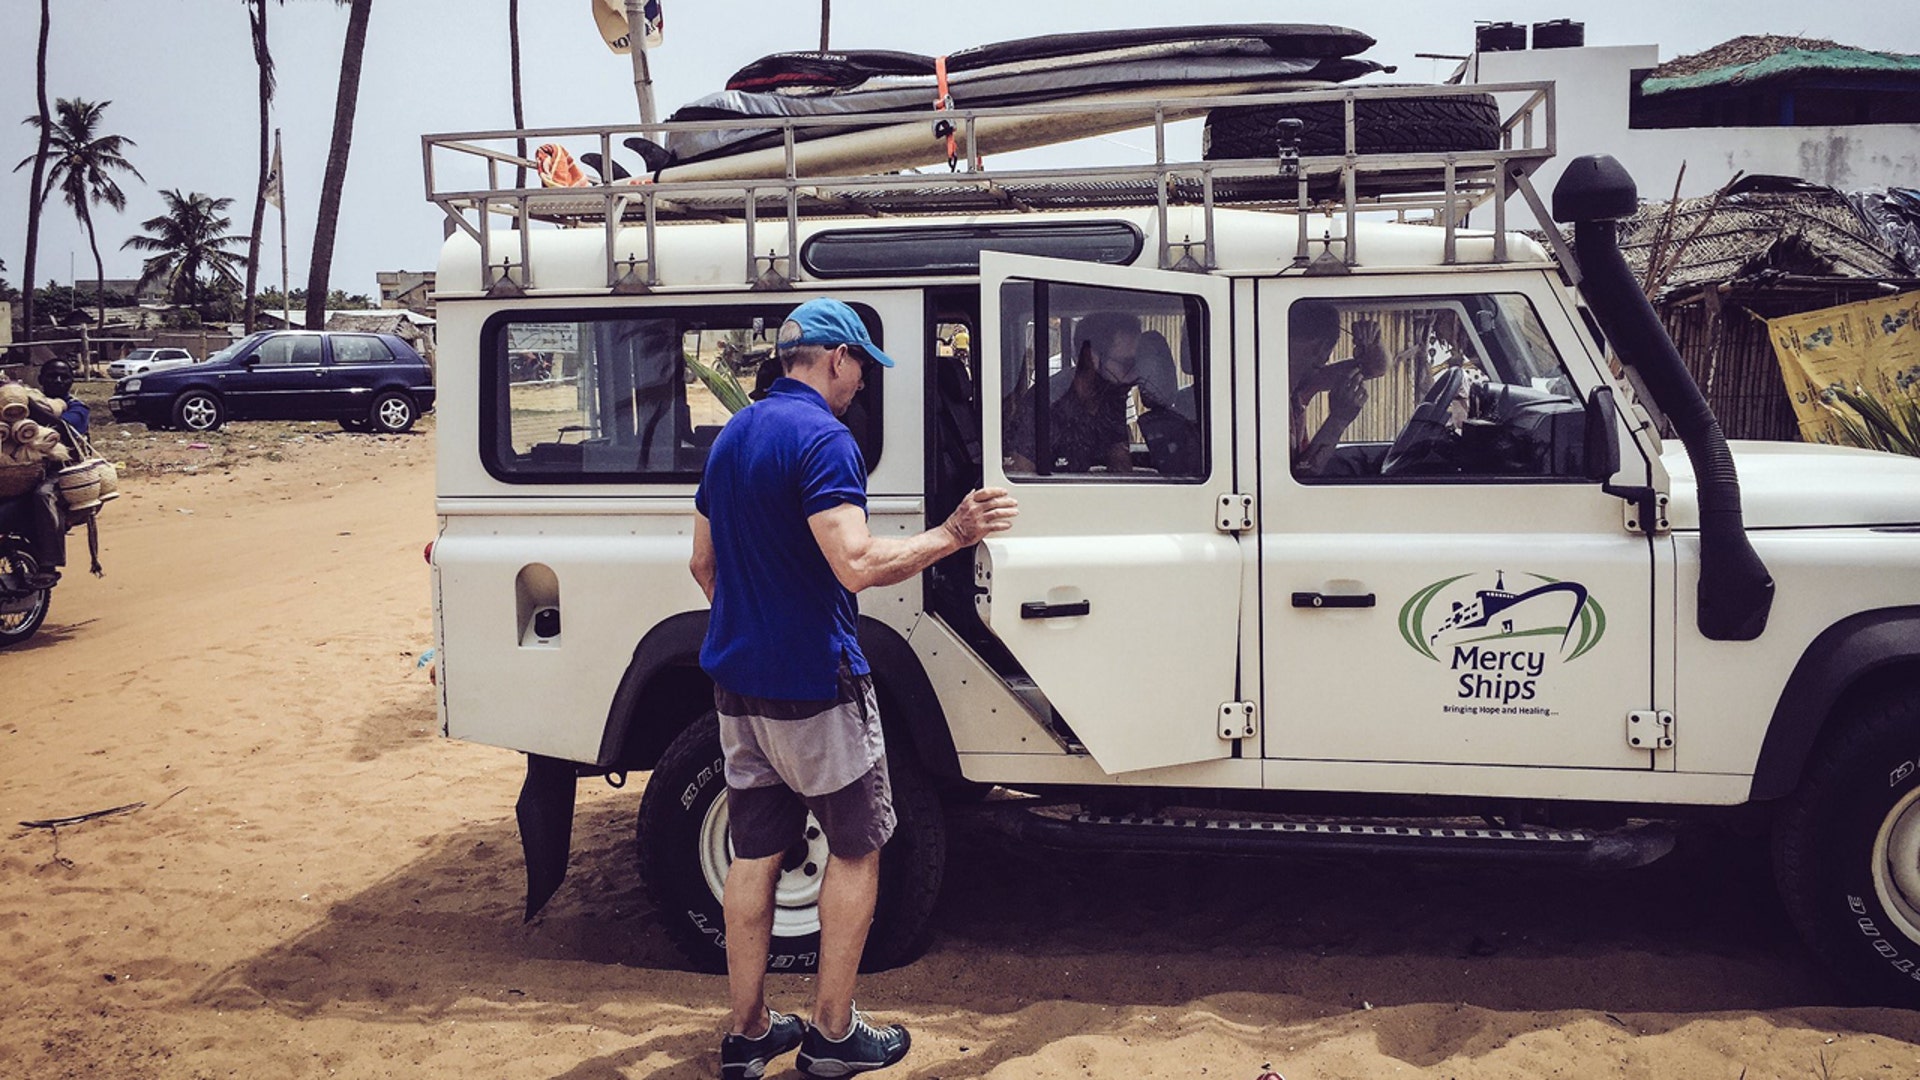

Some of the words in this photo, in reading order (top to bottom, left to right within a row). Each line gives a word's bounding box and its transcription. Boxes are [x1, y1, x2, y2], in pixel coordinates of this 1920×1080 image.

[1450, 646, 1545, 677] Mercy
[1457, 673, 1536, 704] Ships
[1443, 705, 1478, 715] Bringing
[1479, 706, 1500, 715] Hope
[1501, 706, 1517, 715] and
